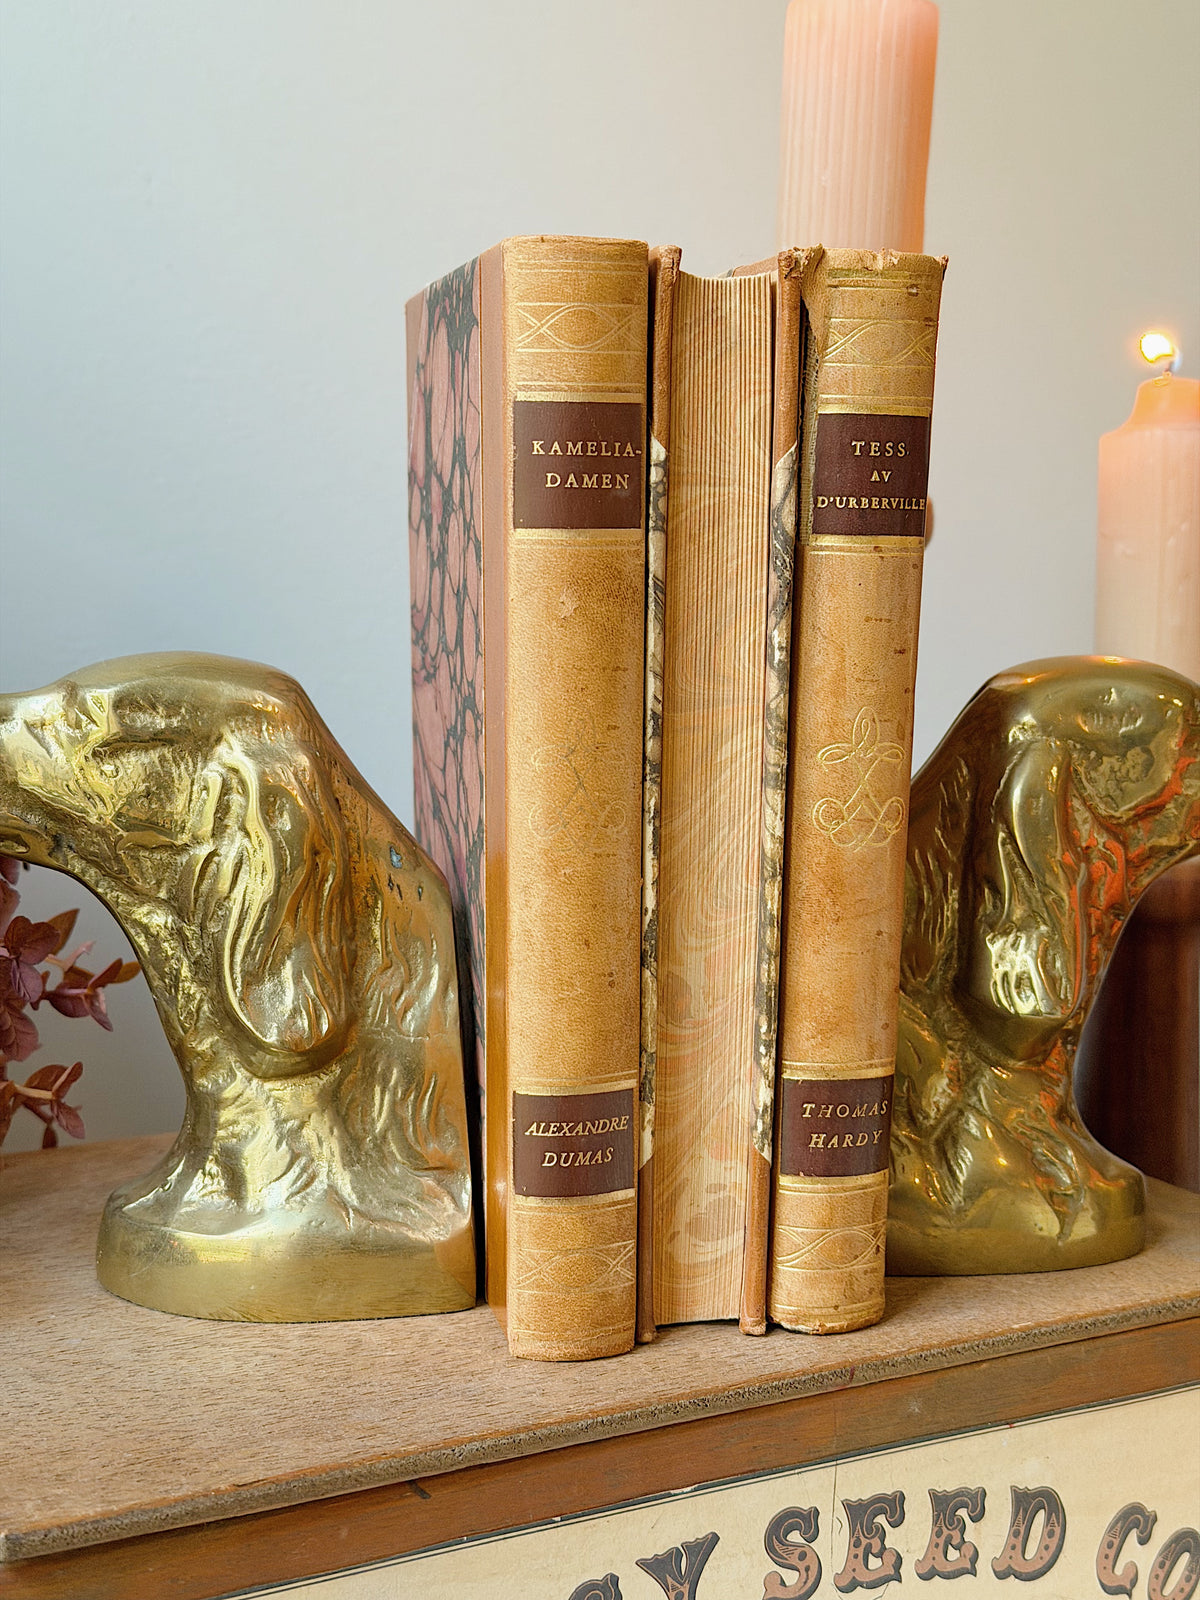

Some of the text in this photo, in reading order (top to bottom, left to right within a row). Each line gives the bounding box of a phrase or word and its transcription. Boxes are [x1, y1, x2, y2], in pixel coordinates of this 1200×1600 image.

[531, 440, 642, 457] KAMELIA-
[851, 440, 906, 457] TESS
[545, 472, 630, 489] DAMEN
[870, 470, 892, 482] AV
[816, 496, 926, 510] D'URBERVILLE
[802, 1100, 888, 1118] THOMAS
[524, 1115, 630, 1137] ALEXANDRE
[808, 1129, 883, 1149] HARDY
[541, 1147, 614, 1167] DUMAS
[761, 1486, 1067, 1600] SEED
